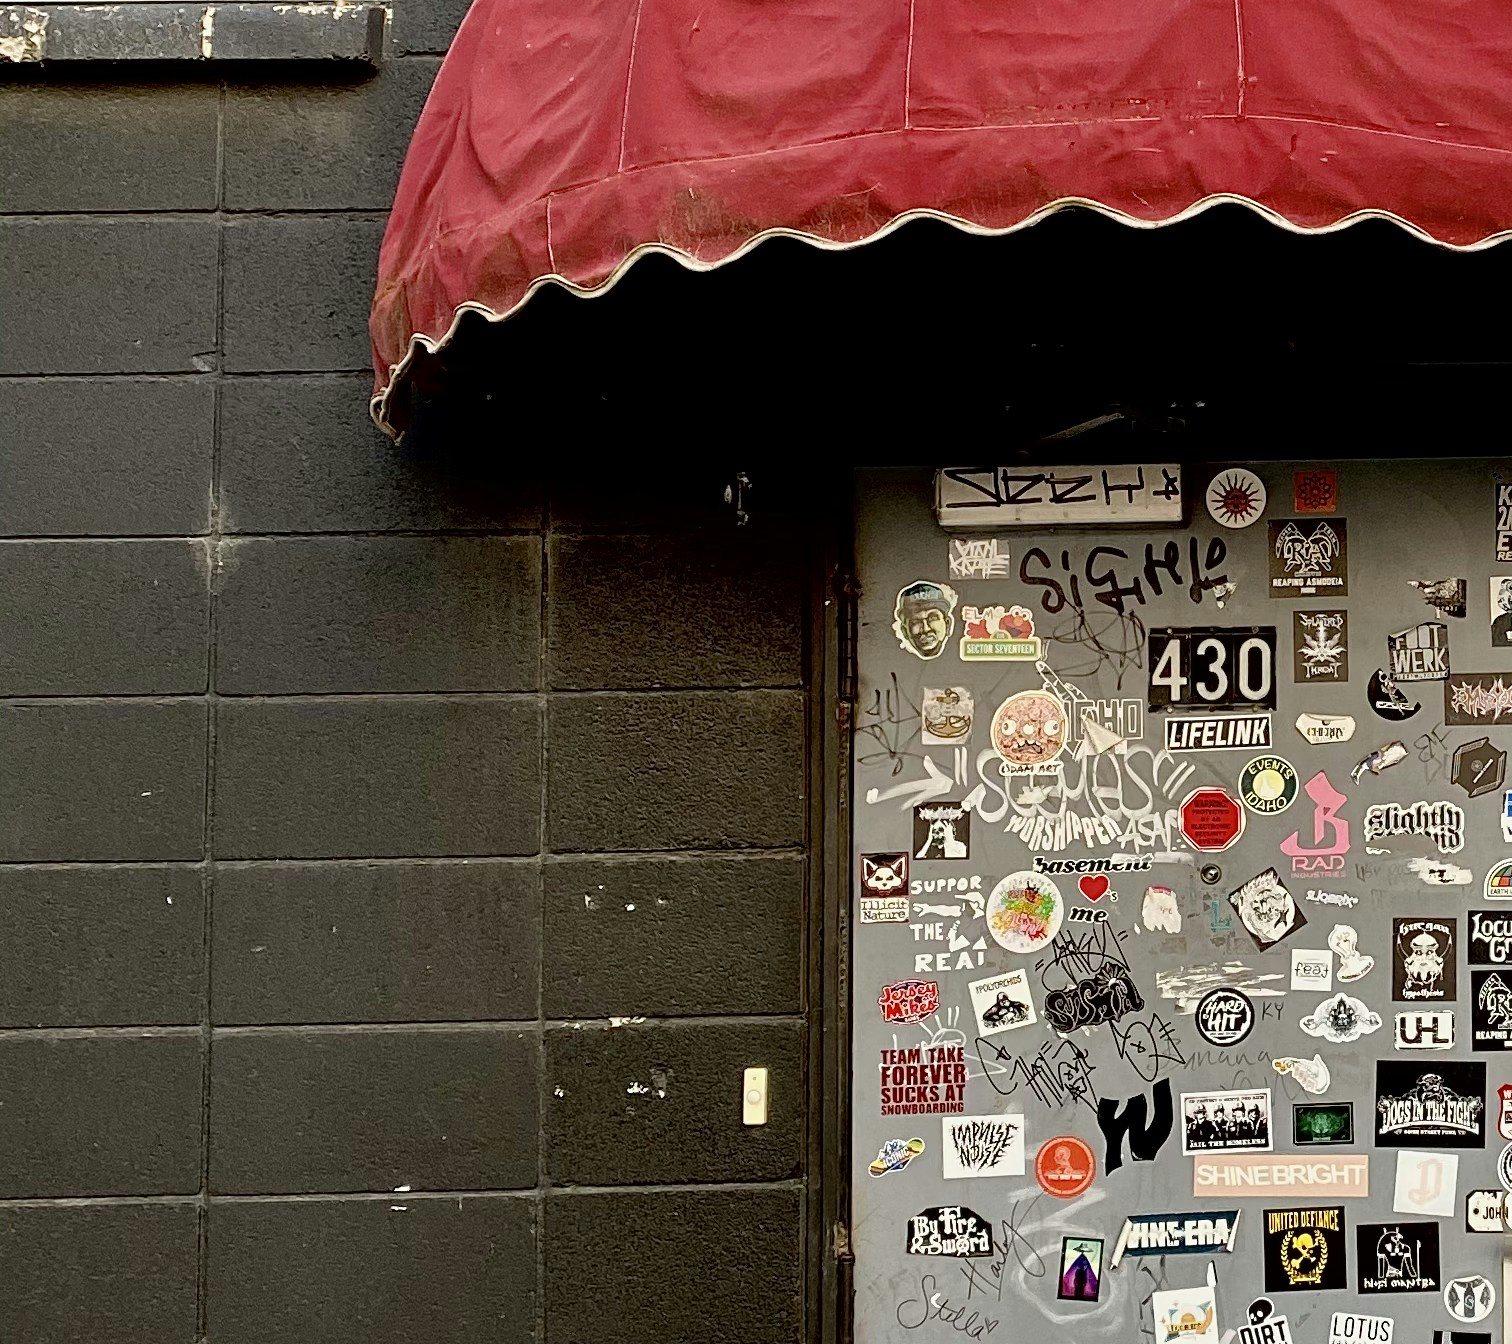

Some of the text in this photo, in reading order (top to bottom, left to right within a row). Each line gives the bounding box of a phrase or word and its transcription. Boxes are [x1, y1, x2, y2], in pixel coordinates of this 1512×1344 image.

[1272, 578, 1304, 587] REAPING
[967, 643, 1035, 654] SECTOR SEVENTEEN
[1151, 637, 1273, 702] 430
[1392, 647, 1446, 674] WERK
[1169, 717, 1267, 748] LIFELINK
[1039, 763, 1061, 773] ART
[1247, 759, 1294, 787] EVENTS
[1245, 792, 1287, 812] IDAHO
[1292, 856, 1345, 871] RAD
[1490, 887, 1508, 895] EARTH
[862, 899, 908, 911] Illicit
[1069, 906, 1107, 922] me
[863, 910, 906, 921] Nature
[909, 923, 944, 941] THE
[879, 983, 937, 1004] Jersey
[1209, 998, 1245, 1014] HARD
[1207, 1012, 1242, 1032] HIT
[881, 1047, 965, 1064] TEAM TAKE
[881, 1063, 966, 1086] FOREVER
[881, 1085, 966, 1105] SUCKS AT
[881, 1102, 965, 1116] SNOWBOARDING
[1383, 1100, 1479, 1128] DOGS IN THE FIGHT
[951, 1120, 1019, 1152] IMPULSE
[1208, 1139, 1225, 1147] THE
[959, 1145, 1006, 1172] NOISE
[912, 1207, 977, 1236] By Fire
[1268, 1209, 1339, 1232] UNITED DEFIANCE
[923, 1233, 989, 1257] Sword
[896, 1274, 984, 1341] Stella
[1333, 1316, 1390, 1341] LOTUS
